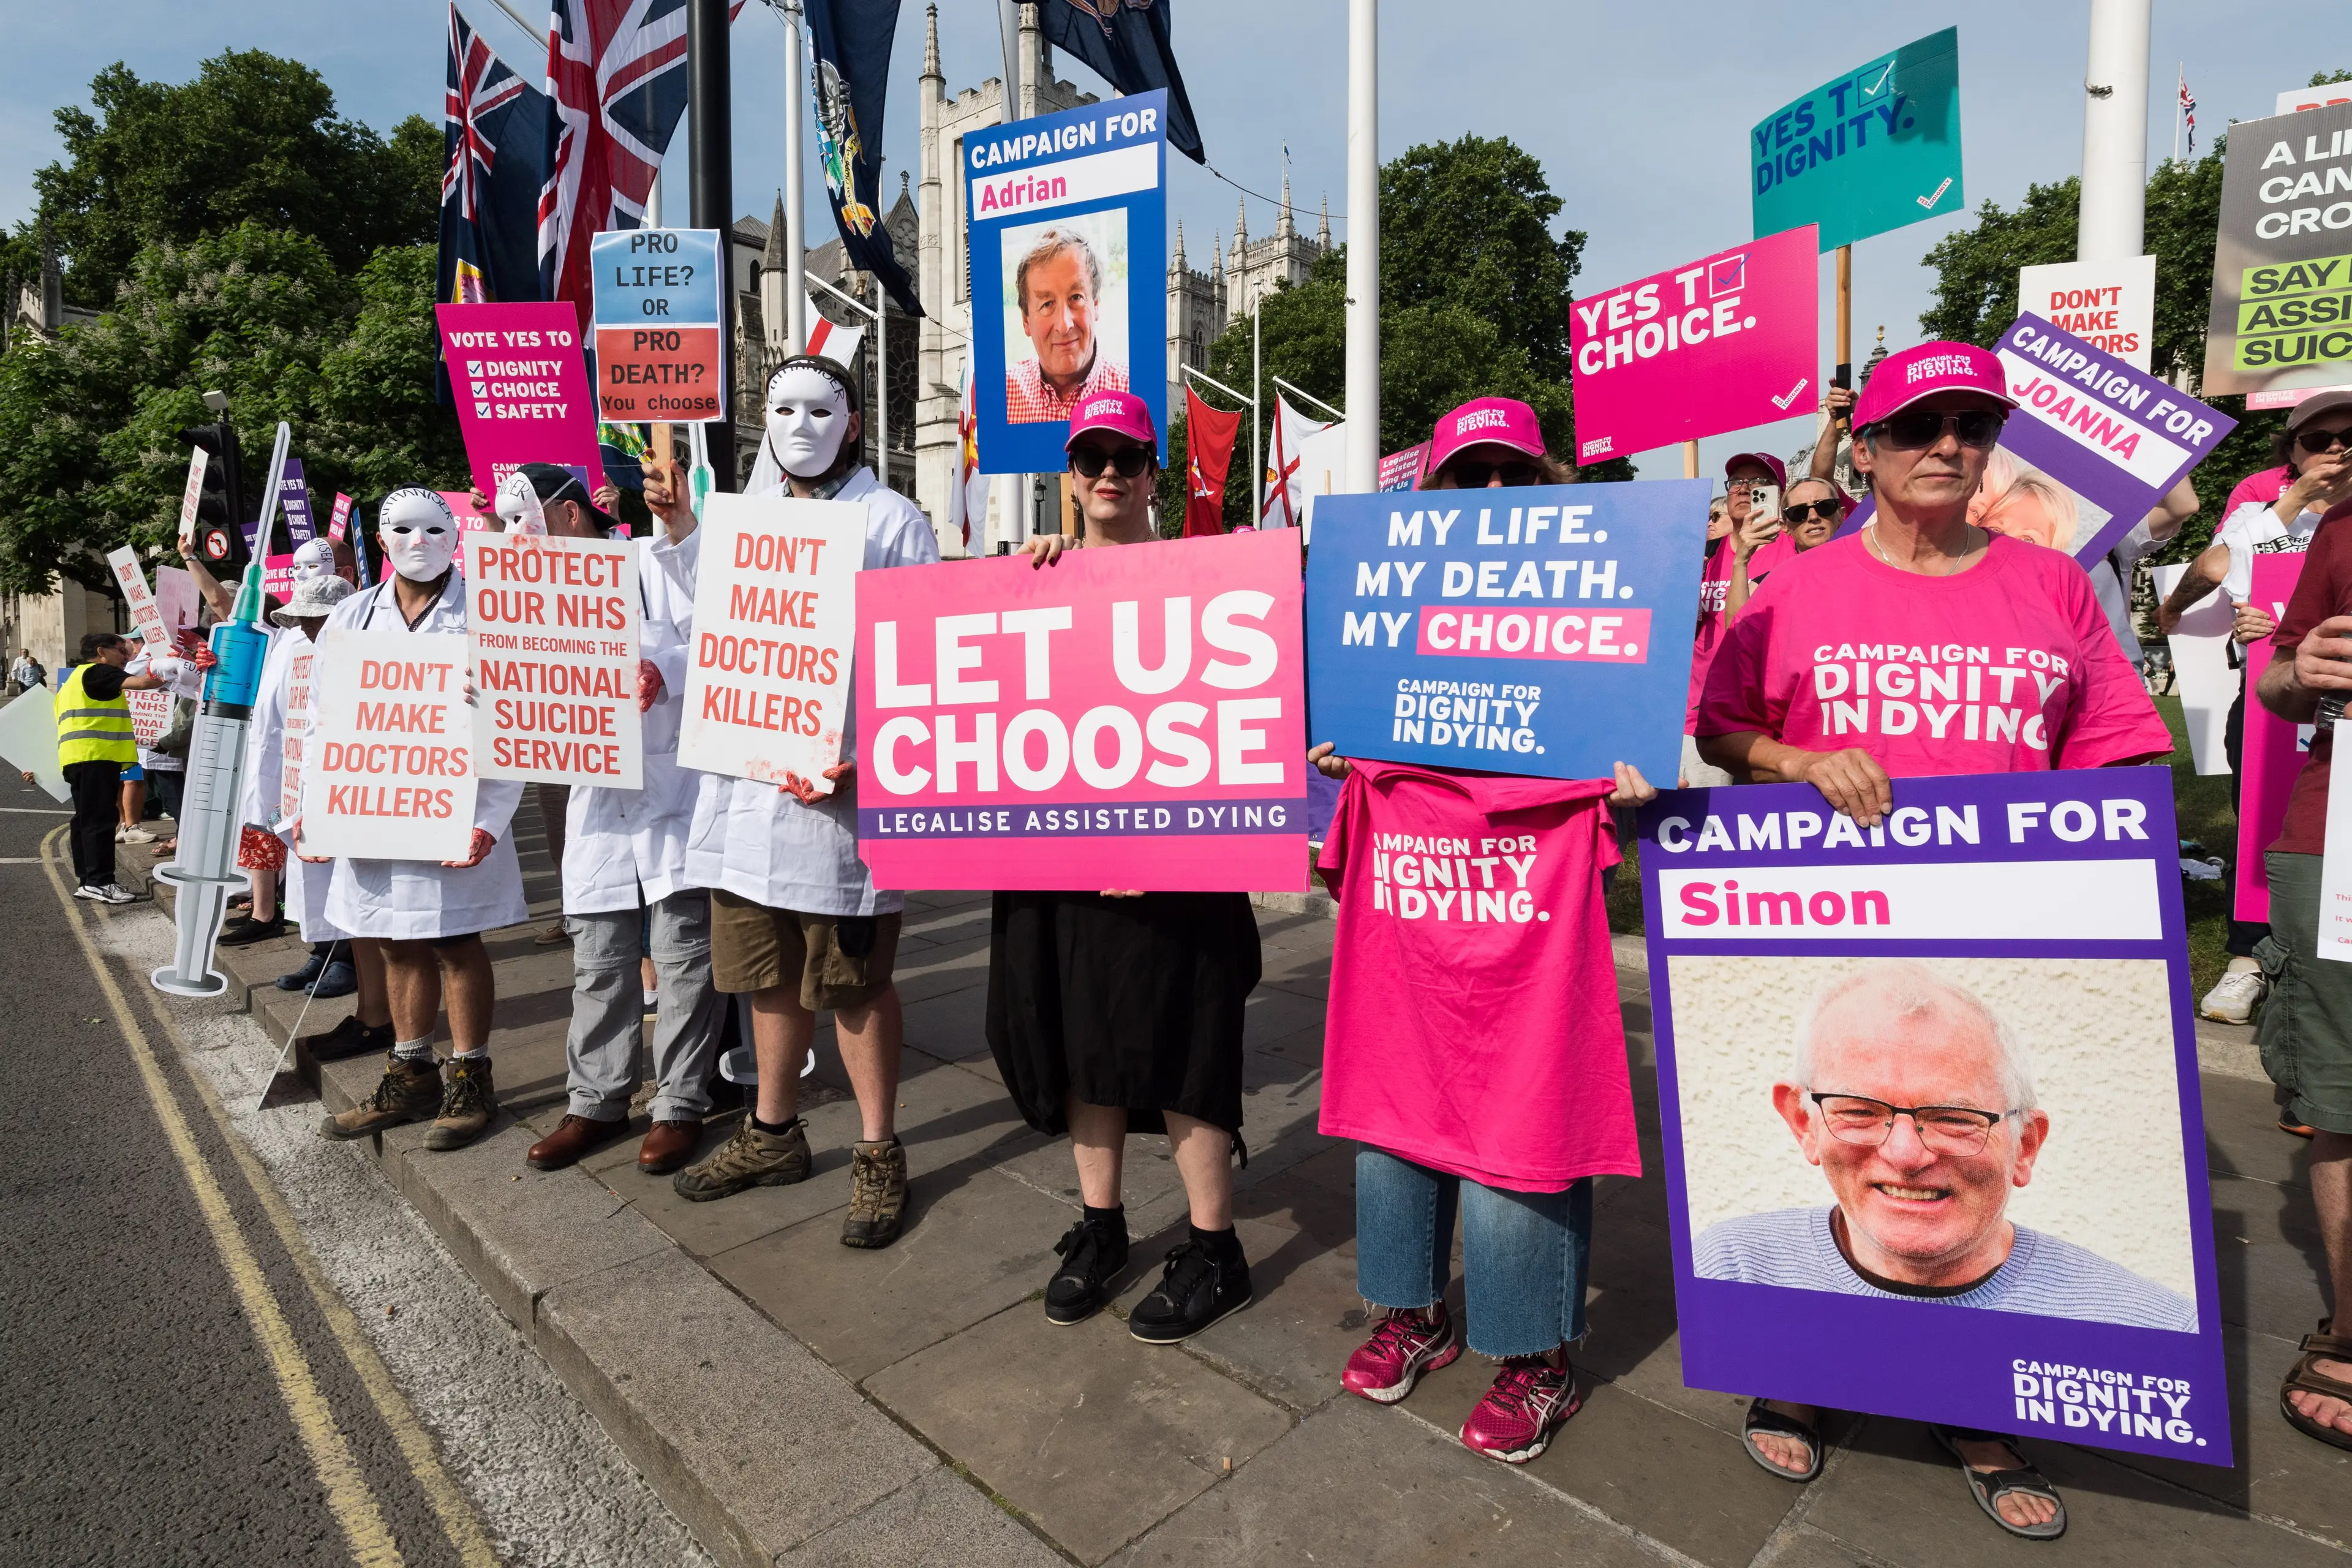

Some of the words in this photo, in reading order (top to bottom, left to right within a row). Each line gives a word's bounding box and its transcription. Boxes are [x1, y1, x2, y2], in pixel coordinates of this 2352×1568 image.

[971, 120, 1096, 169] CAMPAIGN
[1106, 108, 1157, 139] FOR
[1755, 100, 1815, 158] YES
[1757, 95, 1915, 196] DIGNITY.
[2260, 141, 2296, 170] A
[981, 172, 1066, 212] Adrian
[631, 233, 678, 254] PRO
[616, 266, 694, 287] LIFE?
[2250, 260, 2341, 295] SAY
[643, 298, 669, 315] OR
[1577, 284, 1660, 337] YES
[2050, 286, 2122, 311] DON'T
[2051, 311, 2119, 332] MAKE
[2245, 295, 2352, 331] ASSI
[449, 331, 499, 348] VOTE
[503, 331, 539, 347] YES
[545, 331, 572, 347] TO
[633, 331, 680, 352] PRO
[1578, 296, 1757, 375] CHOICE.
[2243, 331, 2352, 366] SUIC
[487, 361, 563, 377] DIGNITY
[611, 363, 705, 385] DEATH?
[1907, 355, 1953, 369] CAMPAIGN
[1907, 360, 1971, 376] DIGNITY
[1907, 373, 1923, 384] IN
[1926, 367, 1978, 378] DYING.
[491, 382, 560, 398] CHOICE
[2013, 325, 2152, 412] CAMPAIGN
[2145, 399, 2214, 448] FOR
[496, 404, 567, 419] SAFETY
[601, 396, 635, 412] You
[647, 395, 716, 410] choose
[1085, 402, 1123, 415] DIGNITY
[1457, 409, 1490, 423] CAMPAIGN
[1457, 413, 1505, 429] DIGNITY
[1457, 426, 1467, 436] IN
[1469, 419, 1510, 431] DYING.
[2013, 377, 2143, 461] JOANNA
[1383, 449, 1419, 469] Legalise
[1583, 439, 1611, 452] DIGNITY
[1591, 445, 1614, 456] DYING.
[1379, 475, 1398, 489] ying
[1401, 467, 1419, 480] and
[1380, 458, 1417, 478] assisted
[287, 479, 296, 490] YES
[296, 478, 304, 489] TO
[1396, 480, 1409, 489] Us
[288, 500, 305, 511] DIGNITY
[291, 514, 307, 525] CHOICE
[381, 488, 453, 526] EUTHANISER
[295, 529, 311, 540] SAFETY
[466, 516, 484, 530] TO
[1387, 510, 1461, 546] MY
[1476, 505, 1607, 545] LIFE.
[478, 546, 625, 588] PROTECT
[734, 532, 826, 576] DON'T
[119, 563, 137, 582] DON'T
[266, 569, 277, 580] GIVE
[278, 568, 287, 579] ME
[1355, 562, 1426, 597] MY
[1441, 560, 1634, 599] DEATH.
[128, 584, 146, 603] MAKE
[265, 582, 279, 593] OVER
[280, 581, 289, 592] MY
[134, 604, 159, 625] DOCTORS
[478, 589, 545, 625] OUR
[557, 594, 626, 630] NHS
[729, 584, 819, 630] MAKE
[143, 625, 166, 644] KILLERS
[480, 633, 518, 650] FROM
[522, 636, 595, 655] BECOMING
[600, 641, 627, 657] THE
[1341, 611, 1412, 647] MY
[1427, 614, 1639, 657] CHOICE.
[698, 632, 840, 686] DOCTORS
[875, 606, 1072, 708] LET
[1112, 590, 1278, 695] US
[1814, 643, 1989, 665] CAMPAIGN
[2005, 647, 2068, 676] FOR
[292, 655, 314, 680] PROTECT
[360, 660, 453, 693] DON'T
[481, 660, 630, 699] NATIONAL
[1398, 679, 1493, 698] CAMPAIGN
[1501, 684, 1542, 701] FOR
[1814, 662, 2066, 709] DIGNITY
[135, 701, 168, 712] NHS
[355, 702, 445, 734] MAKE
[495, 699, 616, 737] SUICIDE
[703, 684, 823, 737] KILLERS
[1396, 695, 1539, 727] DIGNITY
[1820, 698, 1869, 736] IN
[873, 697, 1284, 795] CHOOSE
[1393, 720, 1425, 745] IN
[1430, 722, 1545, 755] DYING.
[322, 742, 468, 777] DOCTORS
[493, 737, 621, 775] SERVICE
[327, 785, 453, 819] KILLERS
[879, 811, 1011, 833] LEGALISE
[1025, 808, 1171, 831] ASSISTED
[1187, 805, 1287, 828] DYING
[1657, 804, 1981, 854] CAMPAIGN
[2007, 798, 2150, 844] FOR
[1480, 835, 1537, 856] FOR
[1399, 888, 1550, 923] DYING.
[1679, 880, 1891, 927] Simon
[2012, 1359, 2133, 1388] CAMPAIGN
[2141, 1375, 2192, 1395] FOR
[2013, 1372, 2192, 1419] DIGNITY
[2015, 1397, 2056, 1426] IN
[2064, 1404, 2207, 1446] DYING.
